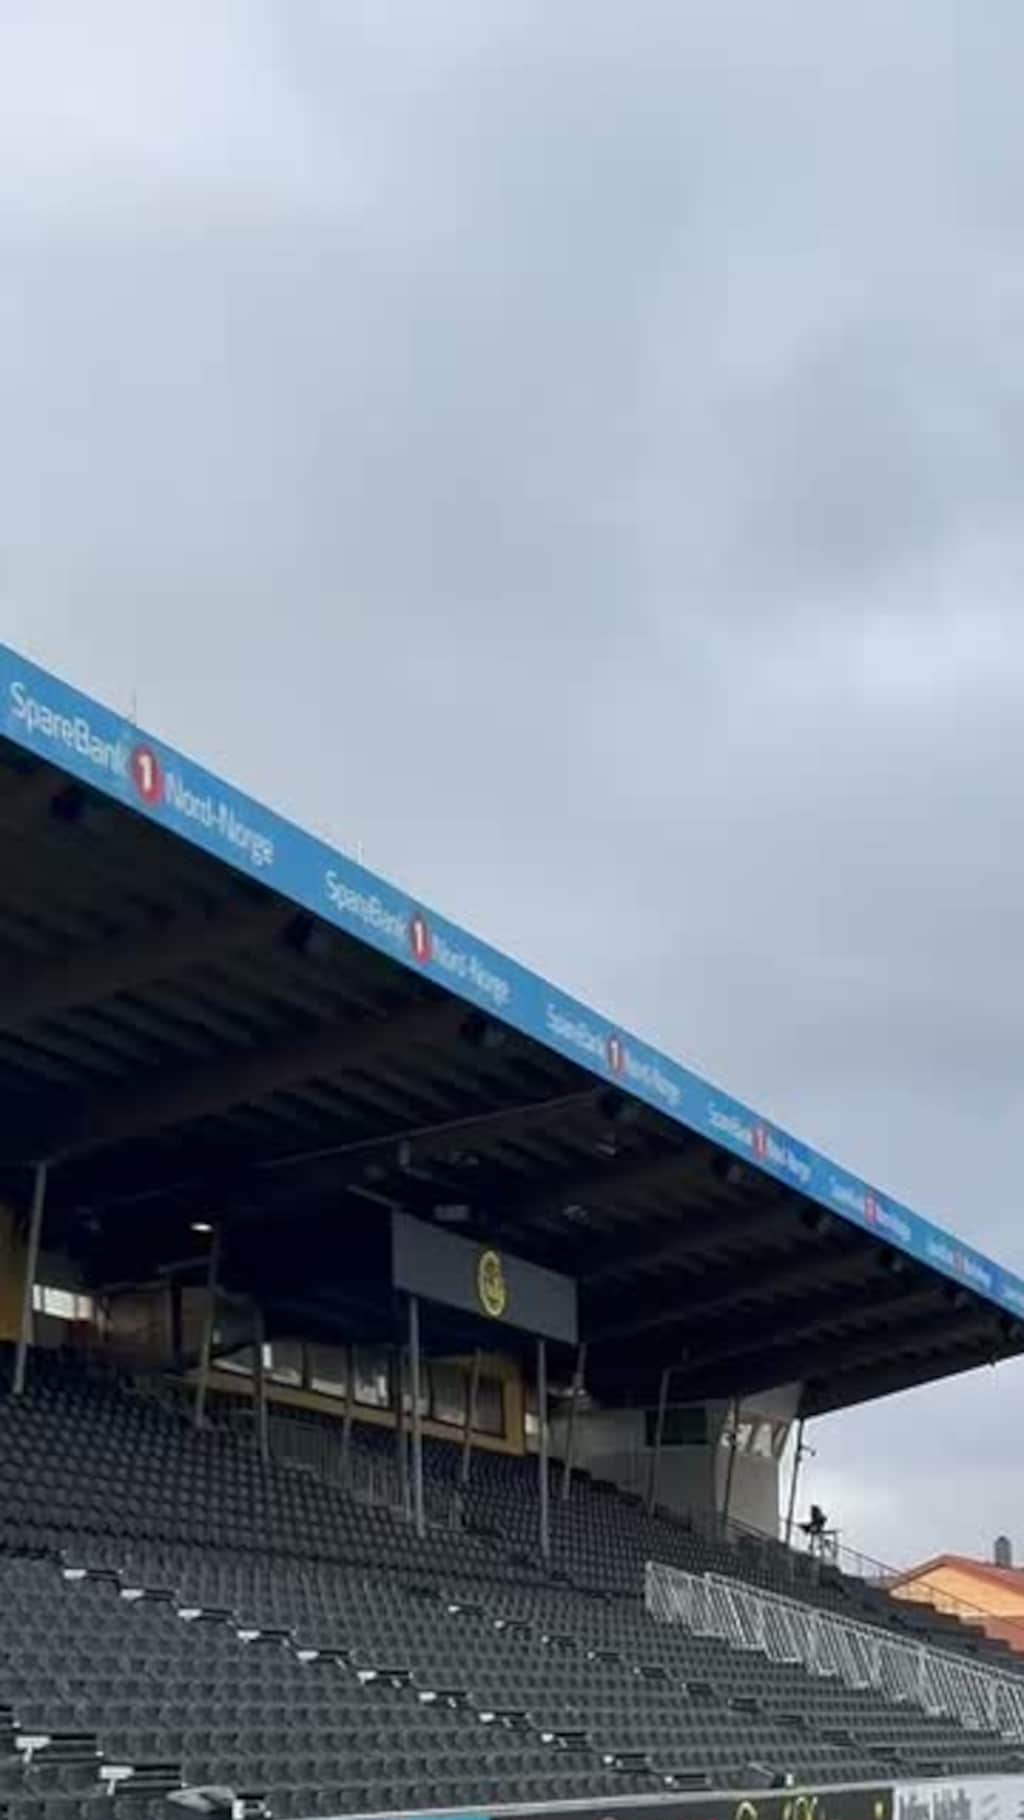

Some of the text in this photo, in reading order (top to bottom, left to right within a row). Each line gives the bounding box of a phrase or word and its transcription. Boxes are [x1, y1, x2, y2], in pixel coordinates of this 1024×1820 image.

[10, 681, 274, 868] SpareBank 1 Nord-Norge
